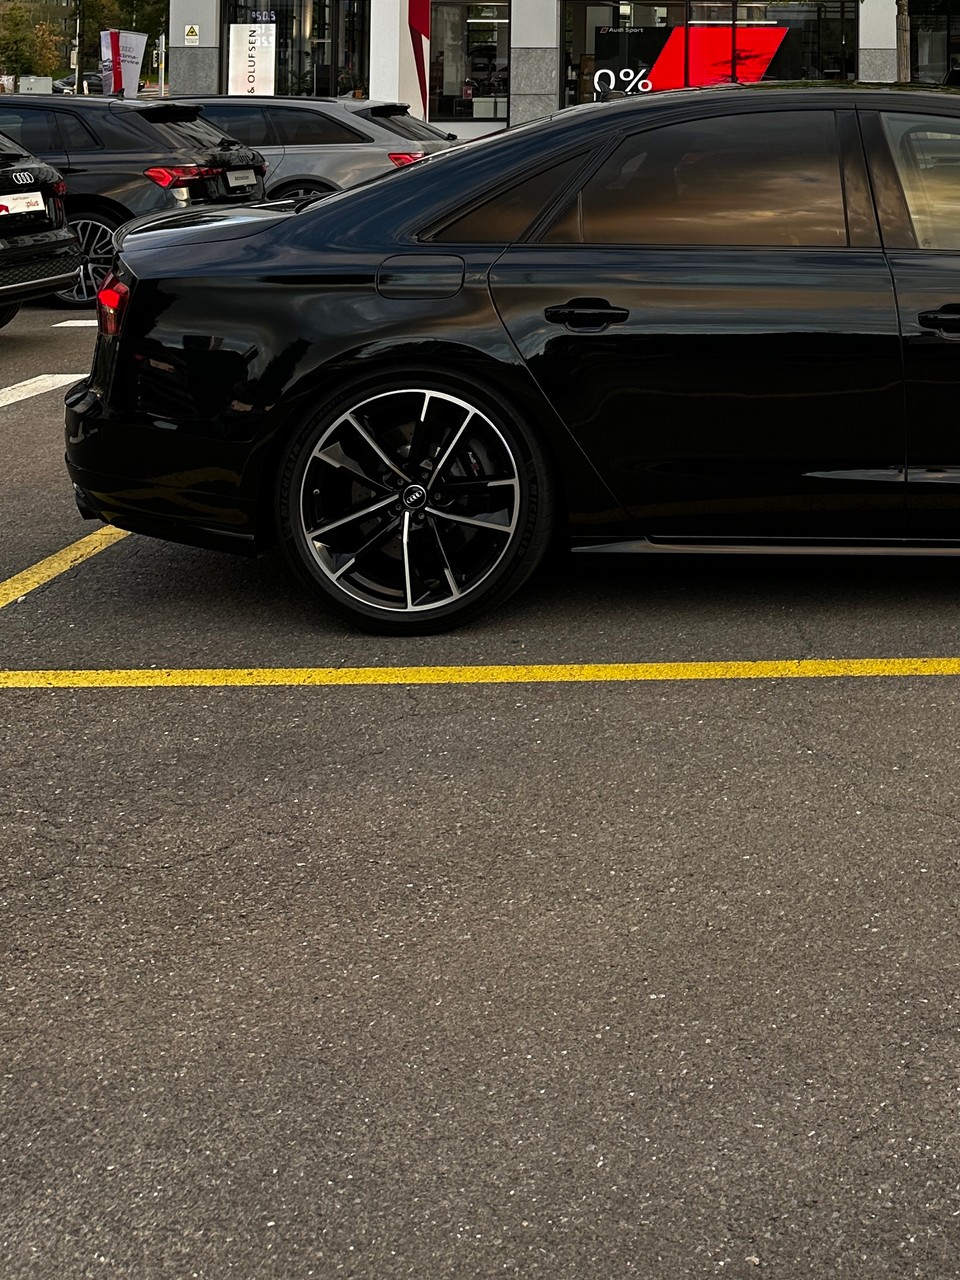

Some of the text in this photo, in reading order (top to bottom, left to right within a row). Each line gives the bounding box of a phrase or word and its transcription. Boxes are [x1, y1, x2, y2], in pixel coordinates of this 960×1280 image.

[247, 29, 257, 94] & OLUFSEN
[593, 68, 653, 93] 0%
